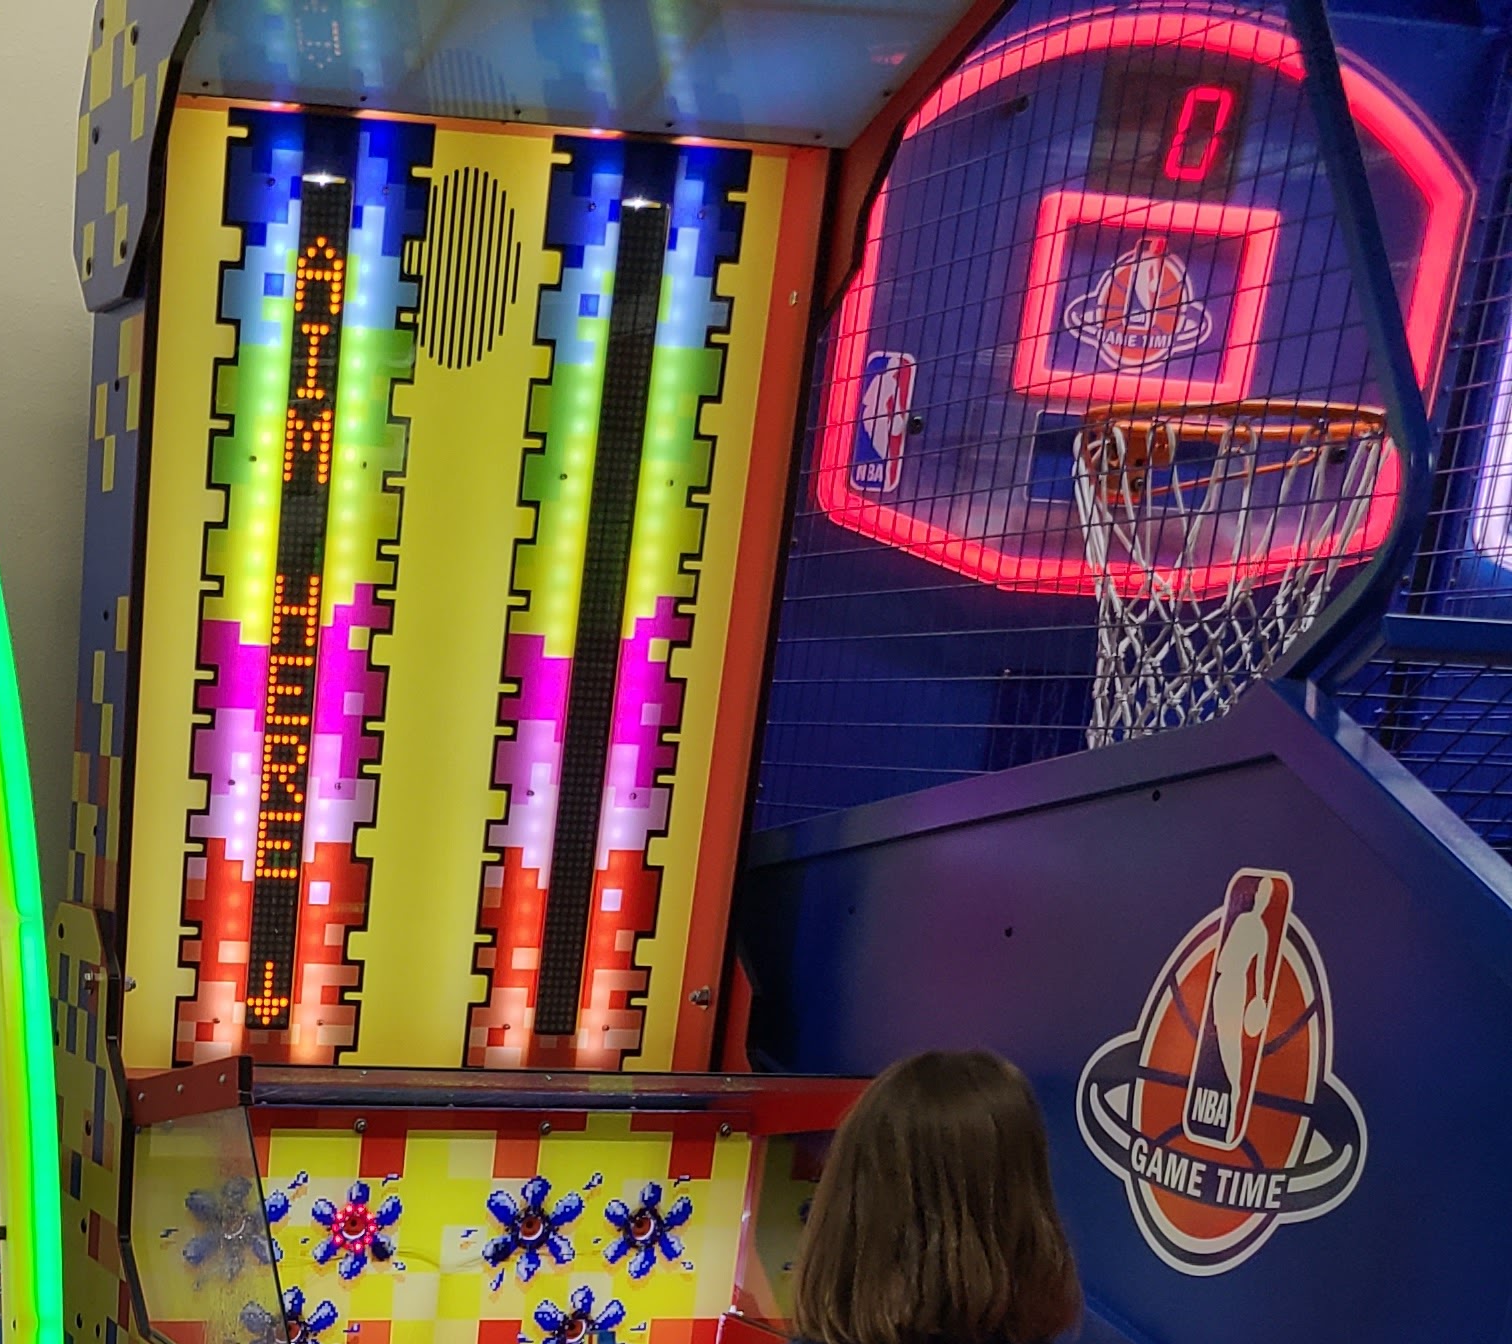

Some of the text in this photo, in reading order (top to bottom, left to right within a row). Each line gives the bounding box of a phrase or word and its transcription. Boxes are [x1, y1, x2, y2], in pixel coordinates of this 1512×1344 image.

[1162, 84, 1235, 182] 0
[281, 235, 345, 485] AIM
[855, 462, 885, 483] NBA
[254, 573, 322, 879] HERE
[1191, 1086, 1232, 1130] NBA
[1130, 1137, 1288, 1209] GAME TIME
